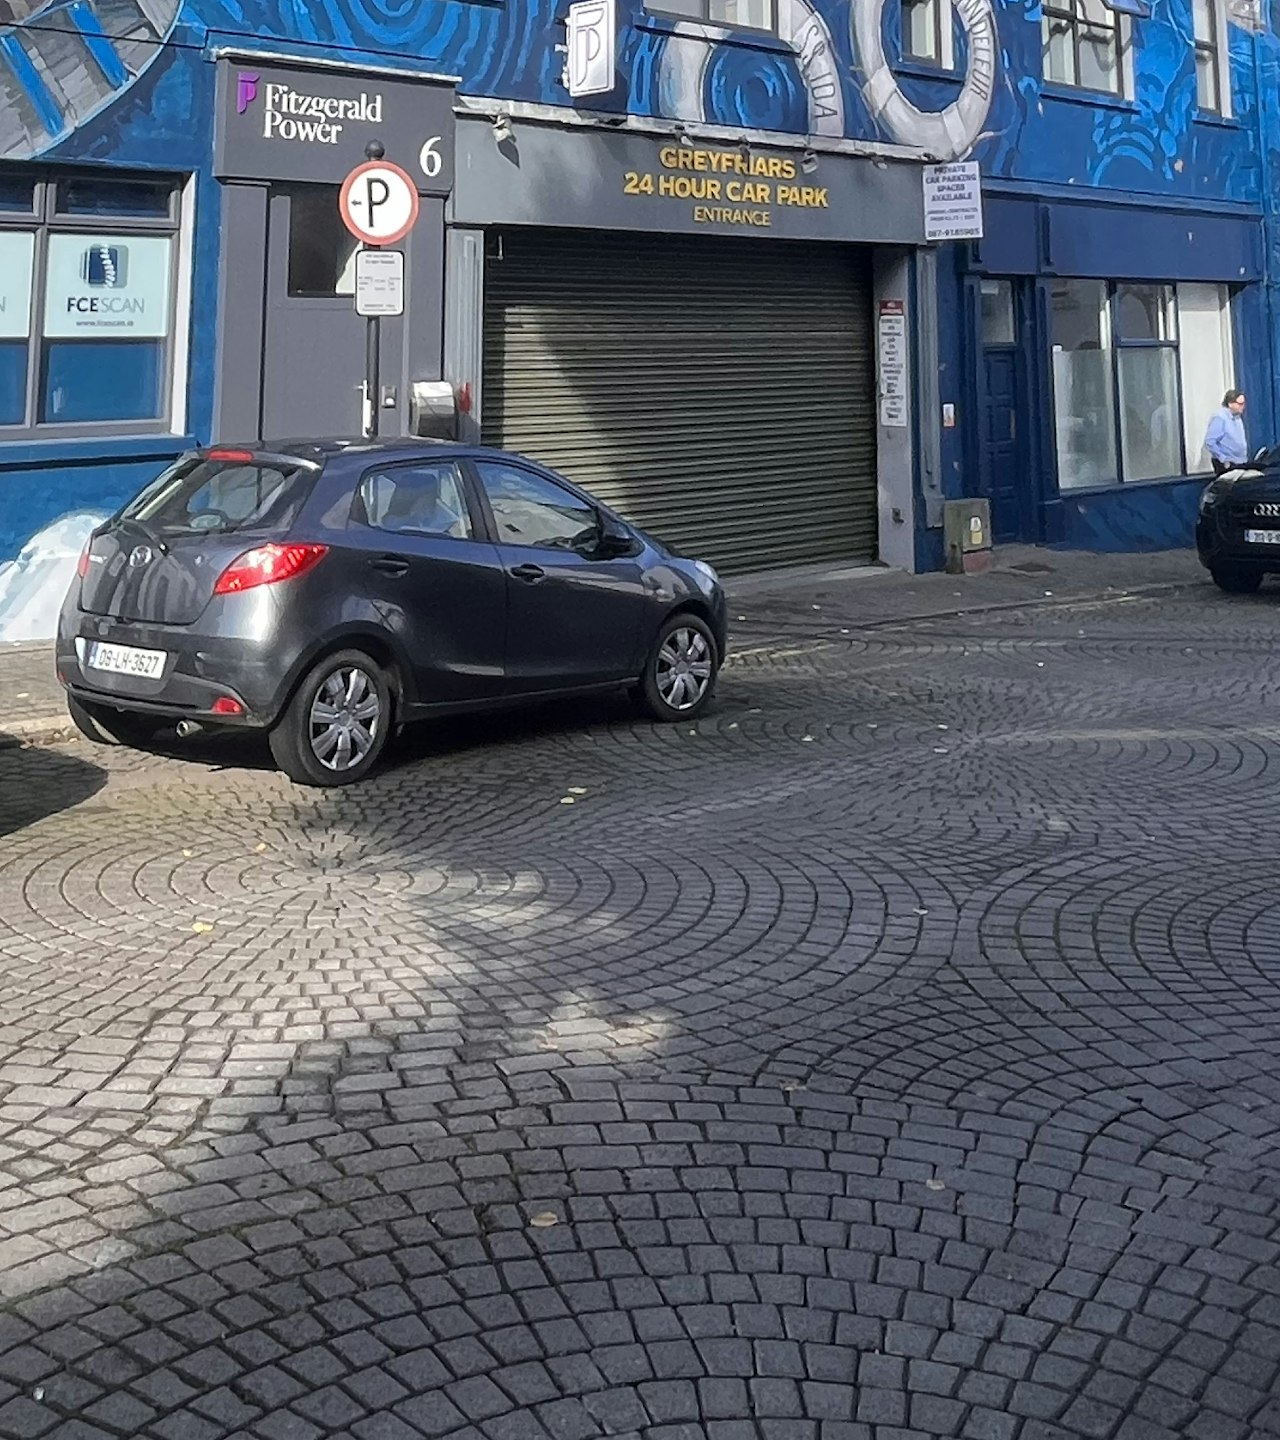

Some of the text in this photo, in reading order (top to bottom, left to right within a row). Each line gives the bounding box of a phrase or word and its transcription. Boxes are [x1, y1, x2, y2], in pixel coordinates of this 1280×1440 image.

[264, 82, 383, 123] Fitzgerald
[262, 111, 343, 144] Power
[420, 135, 442, 177] 6
[659, 146, 796, 180] GREYFRIARS
[366, 177, 390, 228] P
[624, 171, 829, 208] 24 HOUR CAR PARK
[694, 205, 771, 227] ENTRANCE
